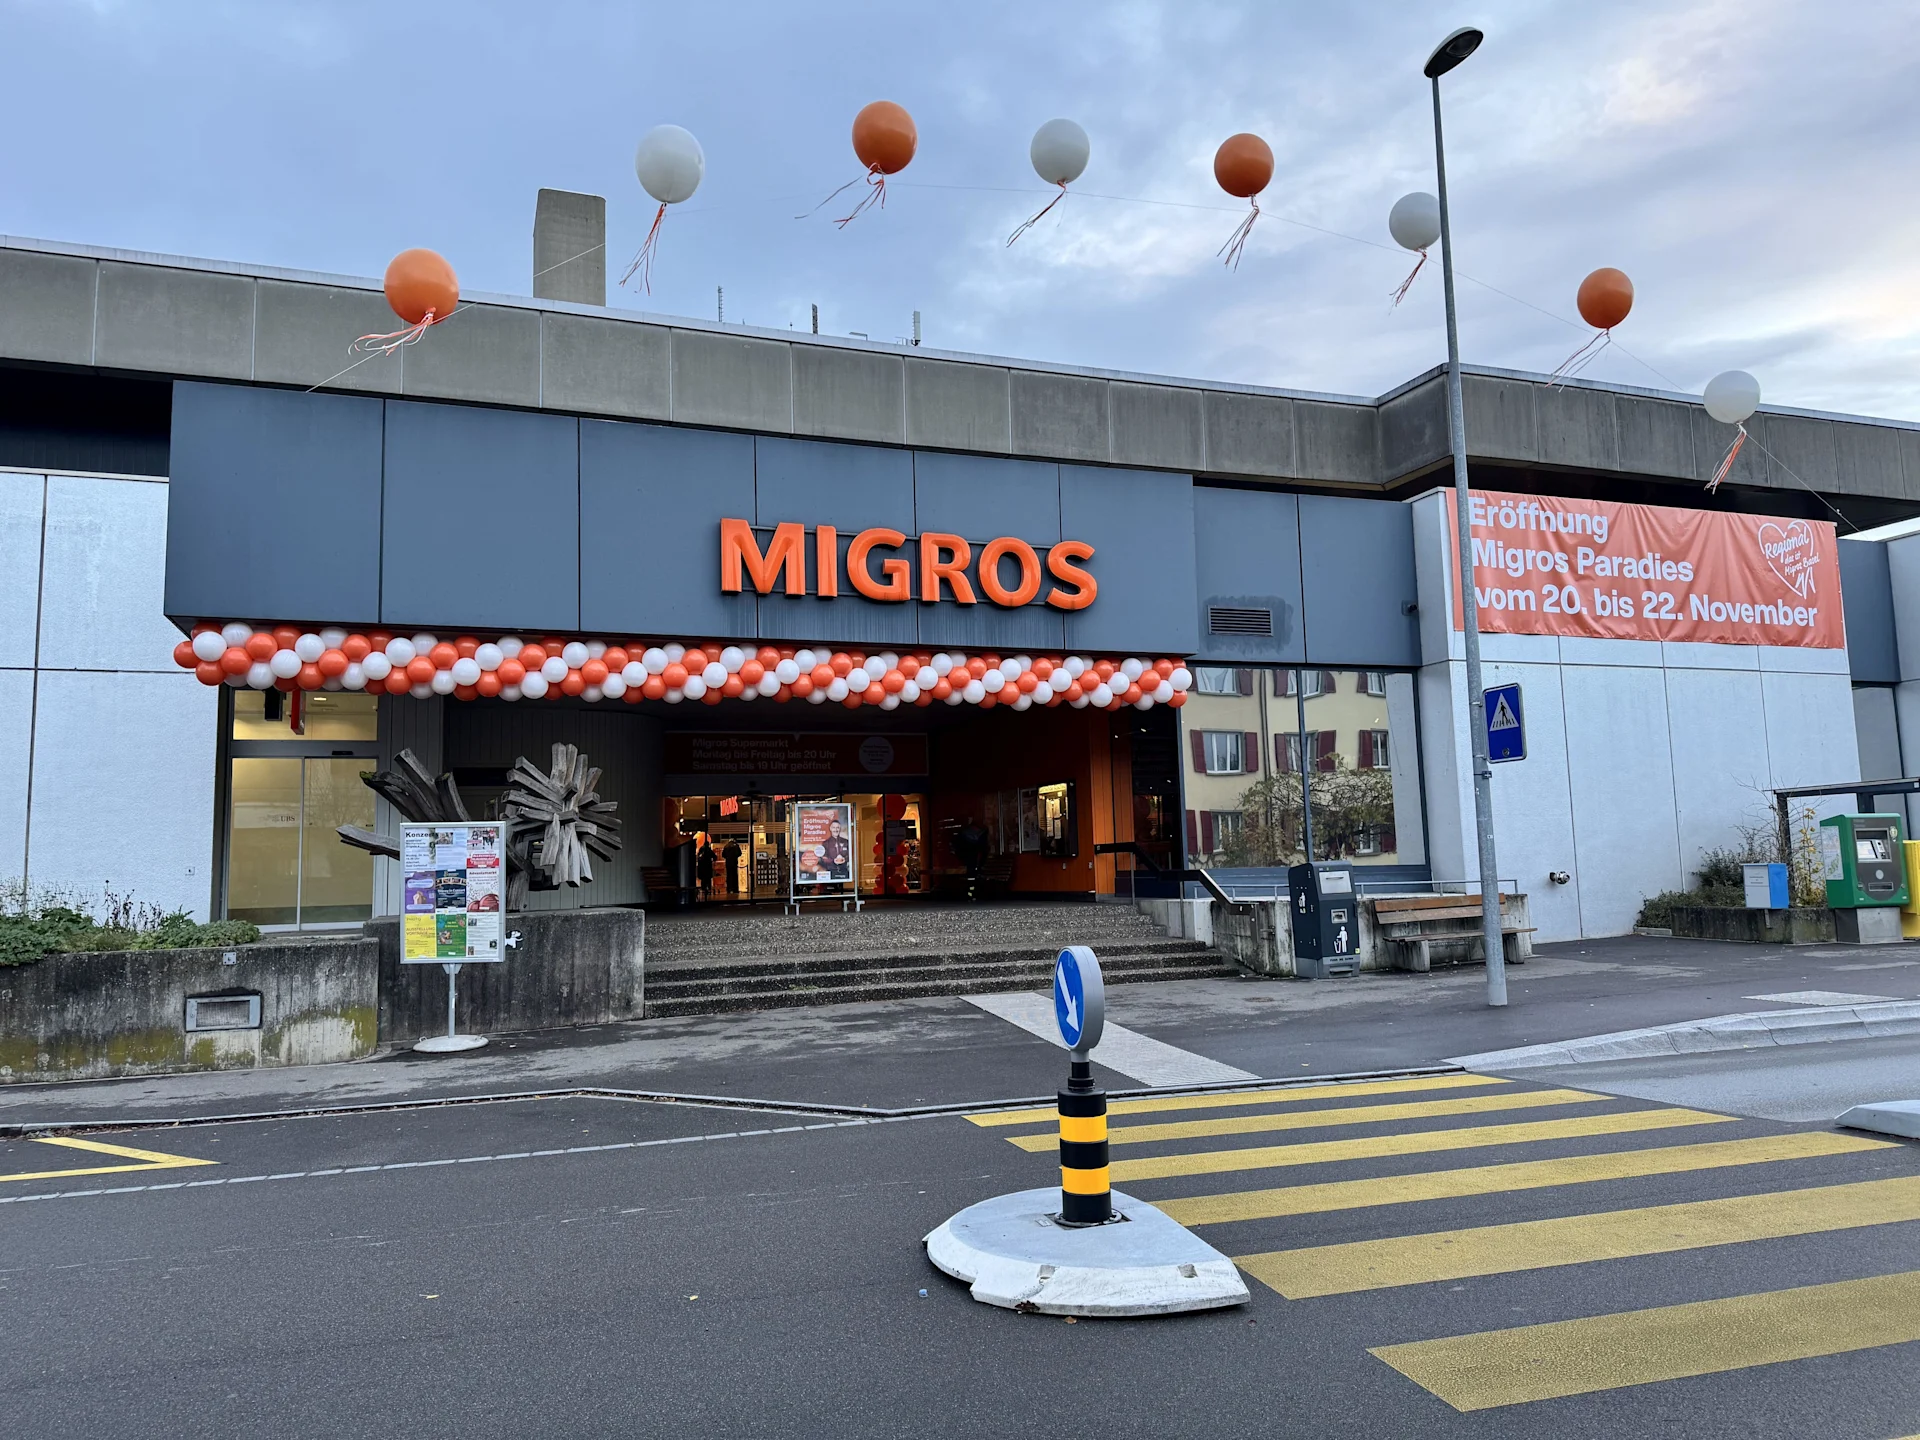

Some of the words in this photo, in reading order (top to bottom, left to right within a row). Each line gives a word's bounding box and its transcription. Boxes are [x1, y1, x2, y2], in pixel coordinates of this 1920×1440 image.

[1468, 497, 1608, 544] Eröffnung
[720, 518, 1098, 610] MIGROS
[1470, 538, 1568, 578] Migros
[1577, 546, 1694, 582] Paradies
[1765, 526, 1809, 564] Regional
[1785, 562, 1802, 578] Migros
[1803, 552, 1820, 568] Basel
[1475, 587, 1536, 611] vom
[1542, 584, 1588, 615] 20.
[1594, 588, 1634, 618] bis
[1642, 590, 1684, 620] 22.
[1690, 594, 1818, 627] November
[692, 739, 728, 748] Migros
[730, 738, 788, 748] Supermarkt
[692, 750, 731, 760] Montag
[733, 750, 748, 758] bis
[750, 750, 784, 760] Freitag
[787, 750, 801, 758] bis
[803, 750, 816, 758] 20
[820, 750, 836, 758] Uhr
[692, 761, 738, 771] Samstag
[740, 761, 754, 769] bis
[770, 761, 788, 769] Uhr
[790, 761, 831, 771] geöffnet
